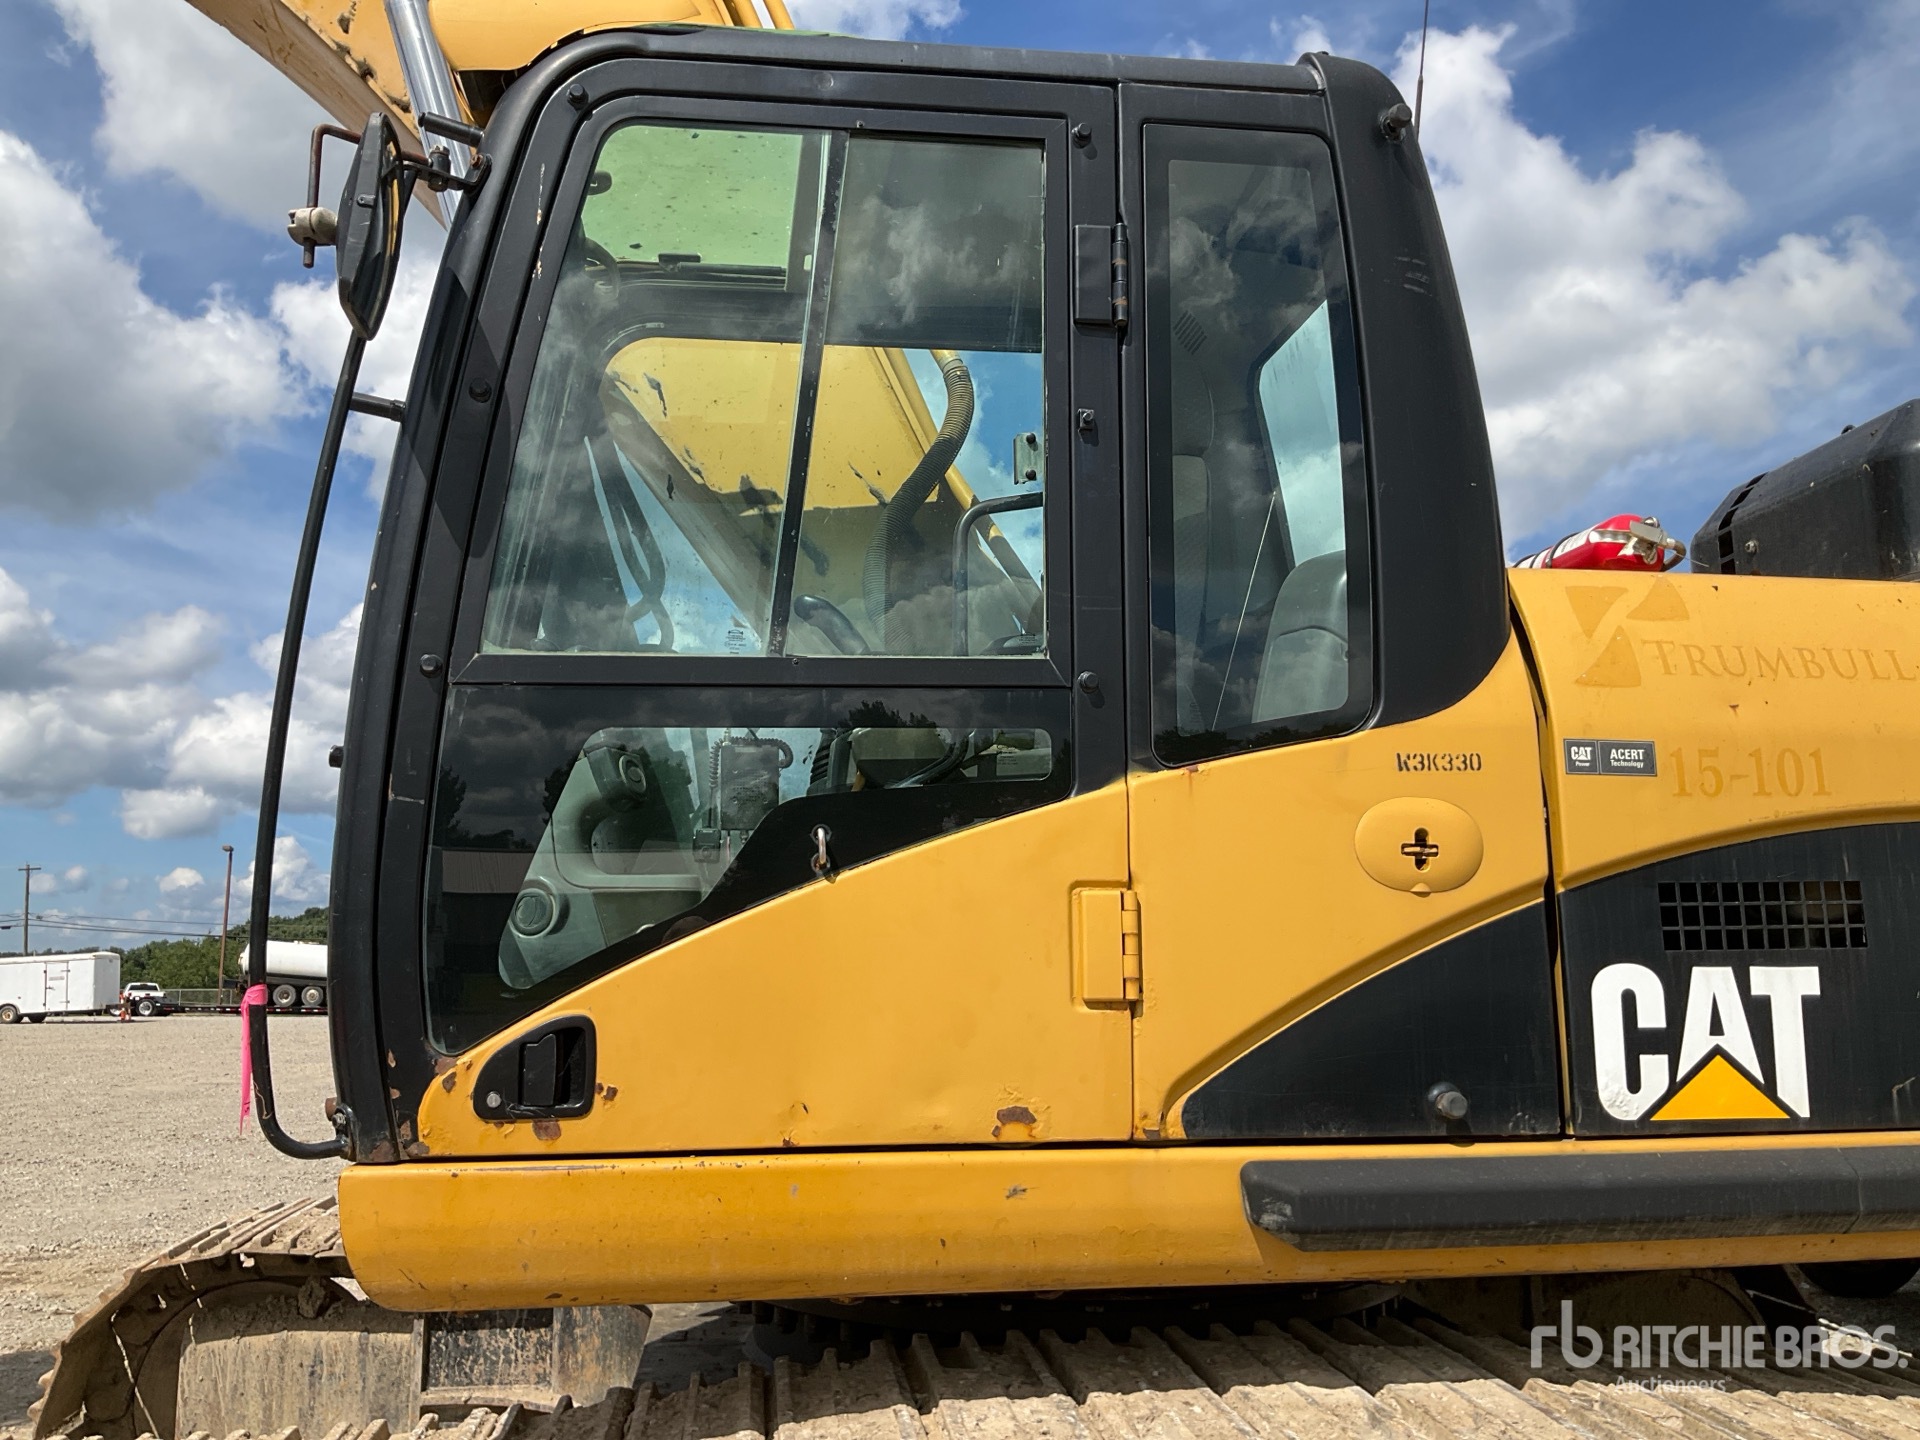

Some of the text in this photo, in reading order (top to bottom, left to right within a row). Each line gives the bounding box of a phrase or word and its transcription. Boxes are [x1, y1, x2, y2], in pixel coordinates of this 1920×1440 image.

[1641, 639, 1917, 681] TRUMBULL
[1570, 746, 1592, 760] CAT
[1609, 748, 1645, 760] ACERT
[1610, 760, 1644, 768] Technology
[1670, 747, 1832, 798] 15-101
[1591, 963, 1821, 1121] CAT
